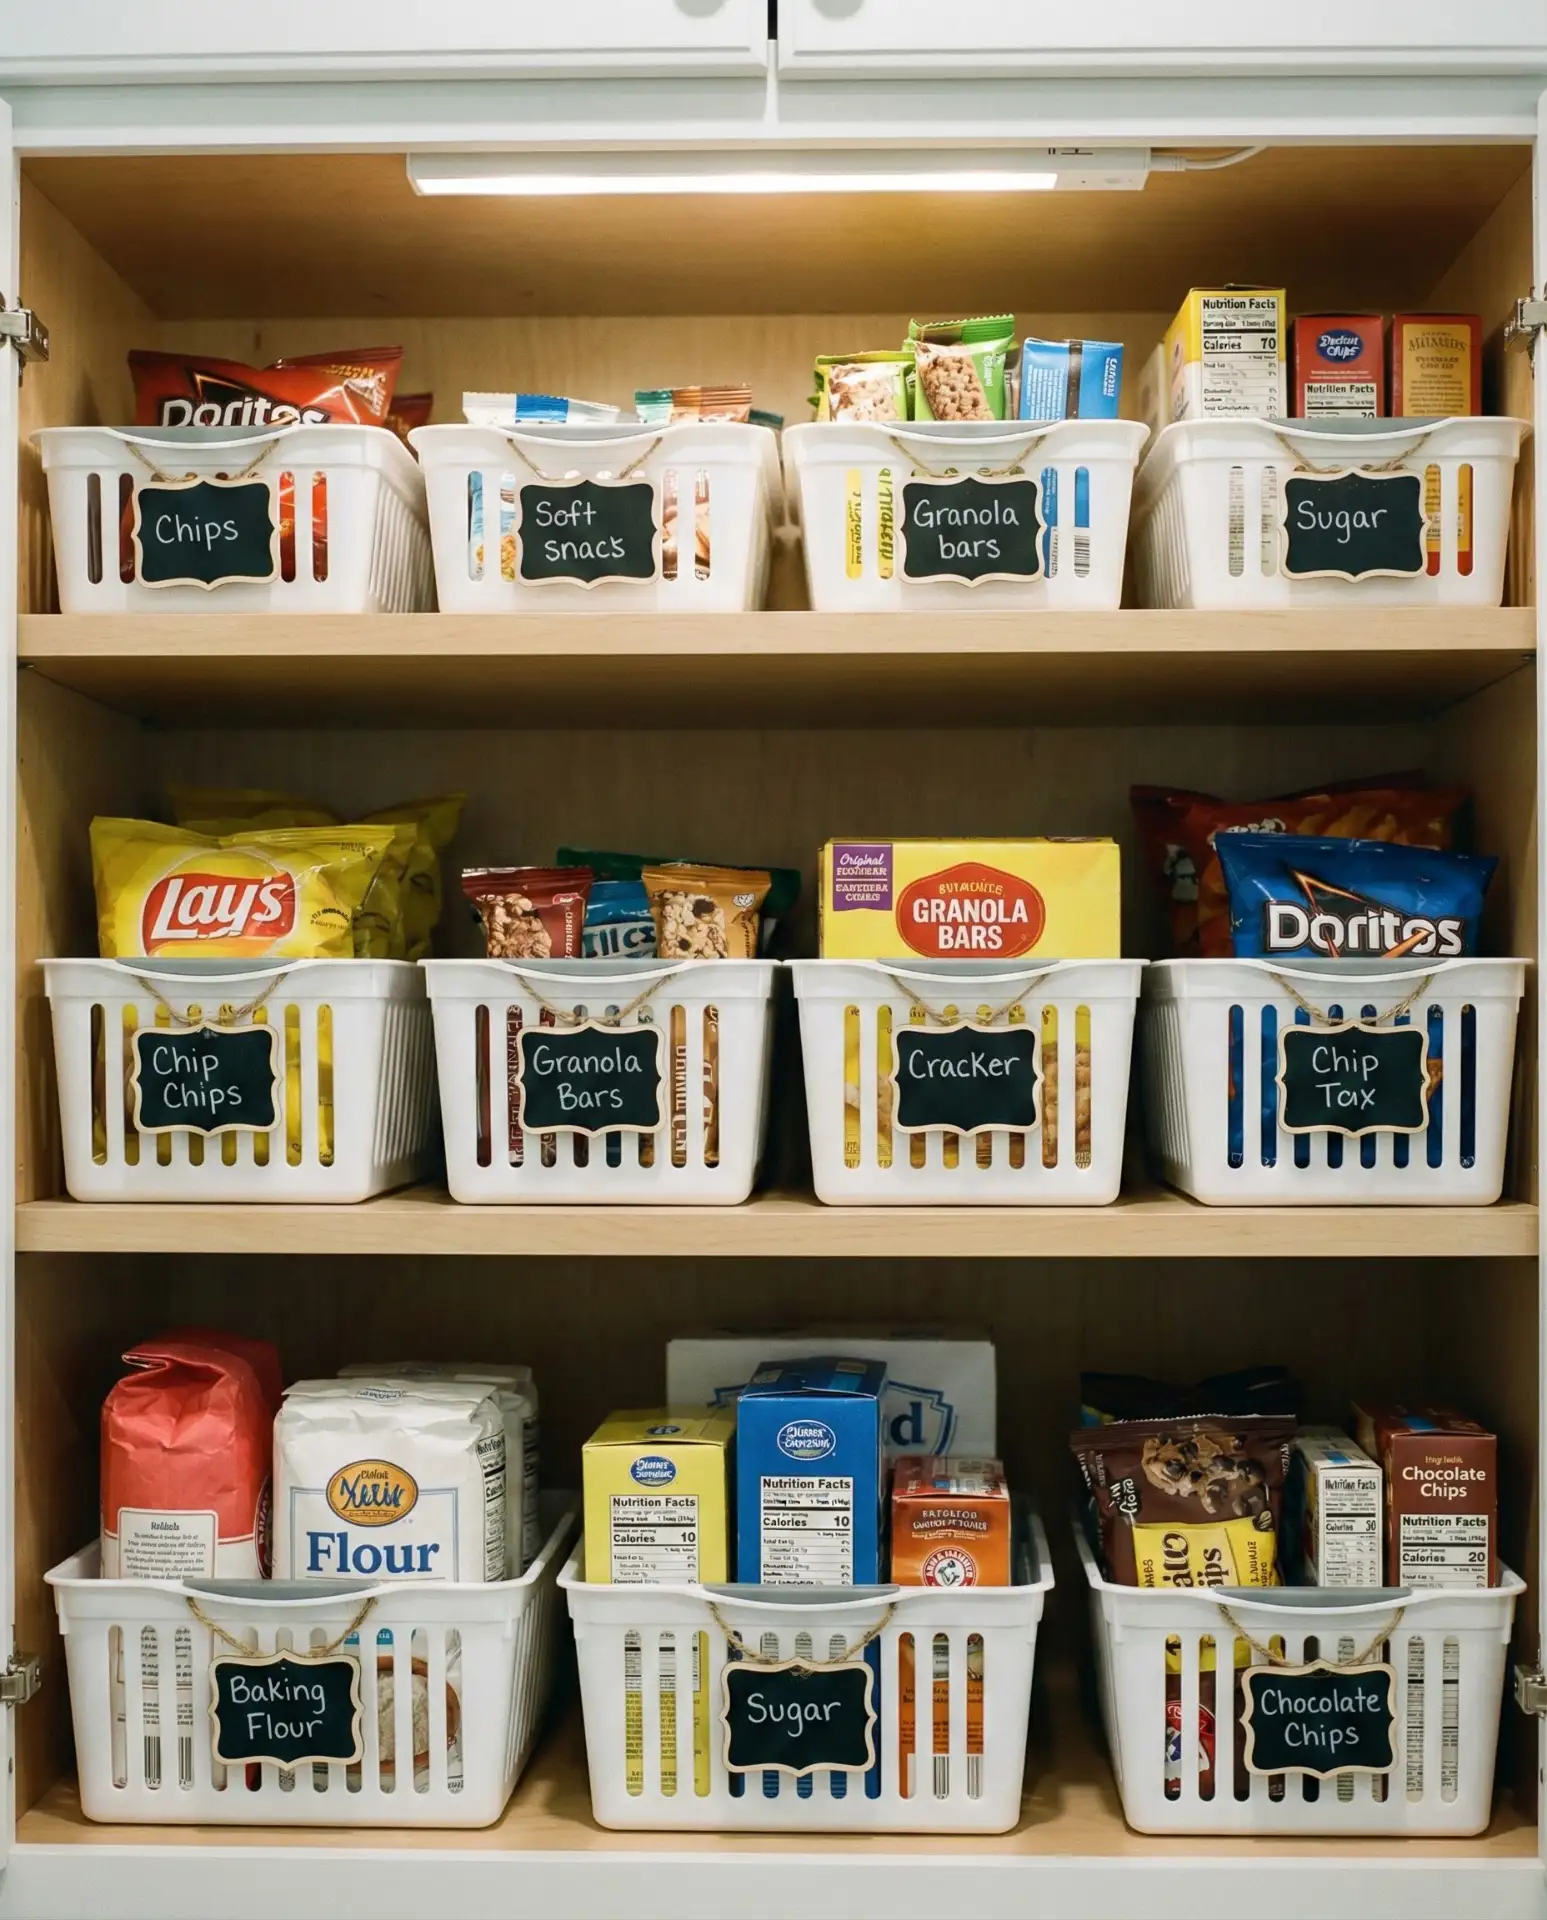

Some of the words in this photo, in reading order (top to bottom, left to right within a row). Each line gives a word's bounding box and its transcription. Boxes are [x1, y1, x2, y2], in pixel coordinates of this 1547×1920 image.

[1261, 337, 1276, 349] 70
[536, 500, 597, 527] Soft
[913, 499, 1020, 529] Granola
[1297, 500, 1388, 544] Sugar
[155, 514, 239, 551] Chips
[938, 534, 1001, 559] bars
[840, 852, 884, 867] Original
[151, 876, 288, 940] Lay's
[912, 899, 1028, 924] GRANOLA
[938, 925, 1003, 950] BARS
[1269, 902, 1463, 956] Doritos
[153, 1046, 219, 1082] Chip
[533, 1045, 643, 1076] Granola
[1312, 1046, 1379, 1082] Chip
[163, 1081, 242, 1115] Chips
[557, 1082, 624, 1111] Bars
[1315, 1082, 1377, 1110] Tax
[762, 1478, 815, 1489] Nutrition
[818, 1478, 851, 1489] Facts
[1402, 1466, 1486, 1481] Chocolate
[665, 1497, 696, 1507] Facts
[1420, 1483, 1468, 1500] Chips
[763, 1517, 807, 1527] Calories
[834, 1516, 850, 1527] 10
[1455, 1517, 1487, 1527] Facts
[613, 1534, 656, 1543] Calories
[681, 1532, 696, 1543] 10
[306, 1532, 441, 1574] Flour
[1468, 1552, 1486, 1563] 20
[230, 1676, 327, 1714] Baking
[1260, 1687, 1381, 1716] Chocolate
[247, 1712, 323, 1740] Flour
[747, 1693, 842, 1738] Sugar
[1284, 1722, 1360, 1754] Chips
